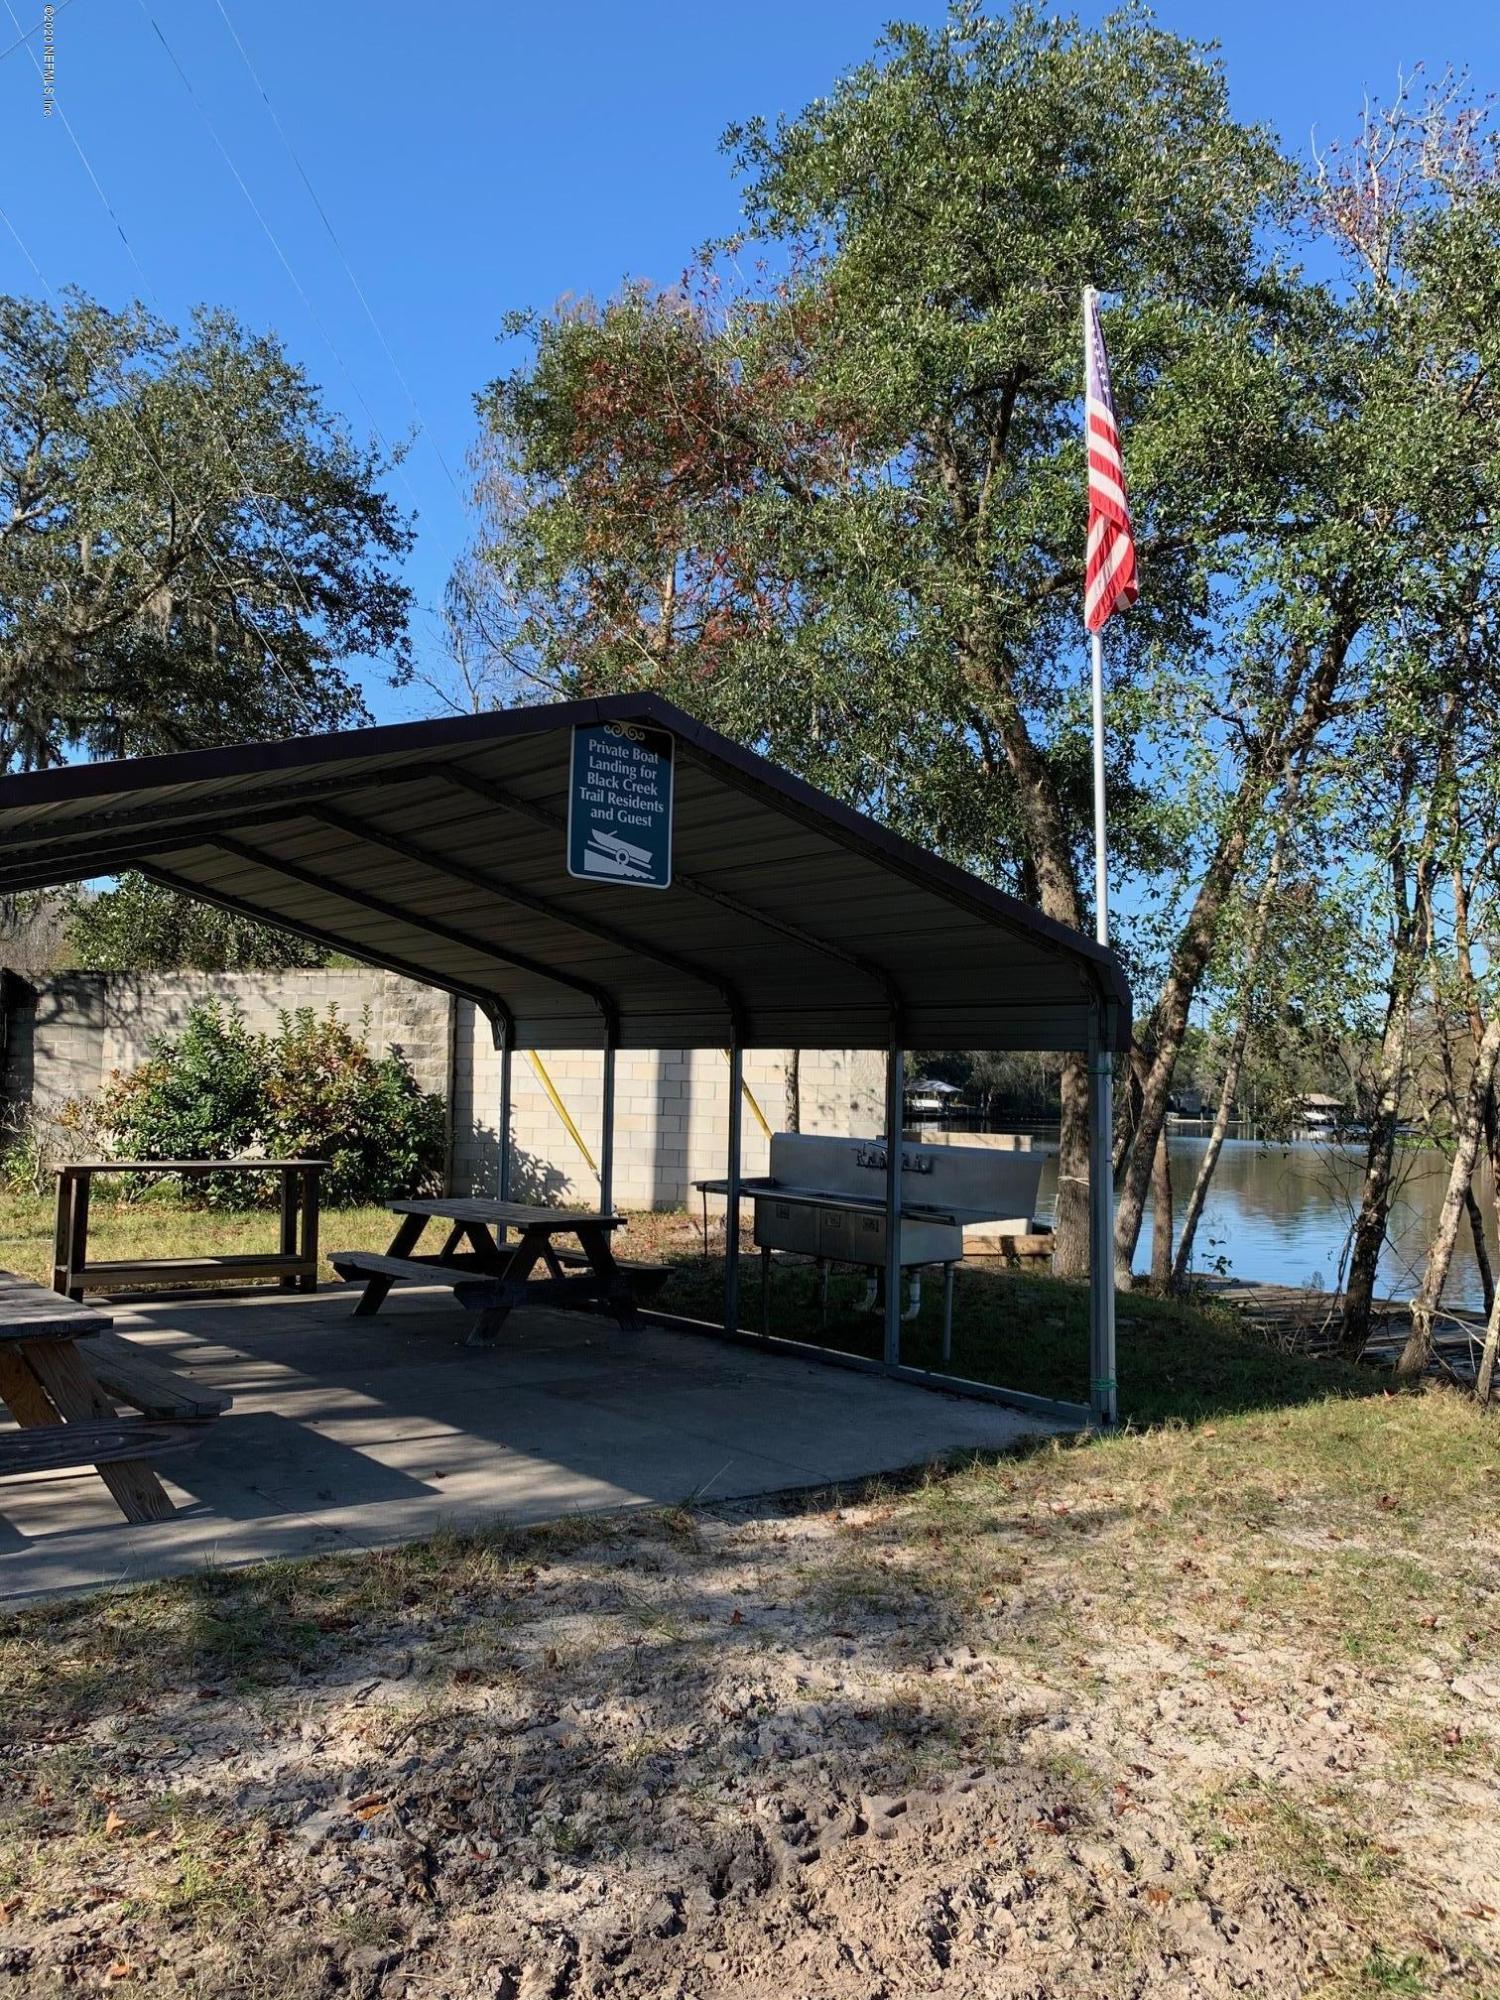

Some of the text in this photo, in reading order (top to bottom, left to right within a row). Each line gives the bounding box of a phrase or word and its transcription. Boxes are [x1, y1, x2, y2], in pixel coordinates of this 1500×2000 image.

[588, 739, 659, 765] Private Boat
[589, 755, 657, 780] Landing for
[587, 771, 658, 796] Black Creek
[579, 786, 664, 813] Trail Residents
[590, 807, 652, 827] and Guest
